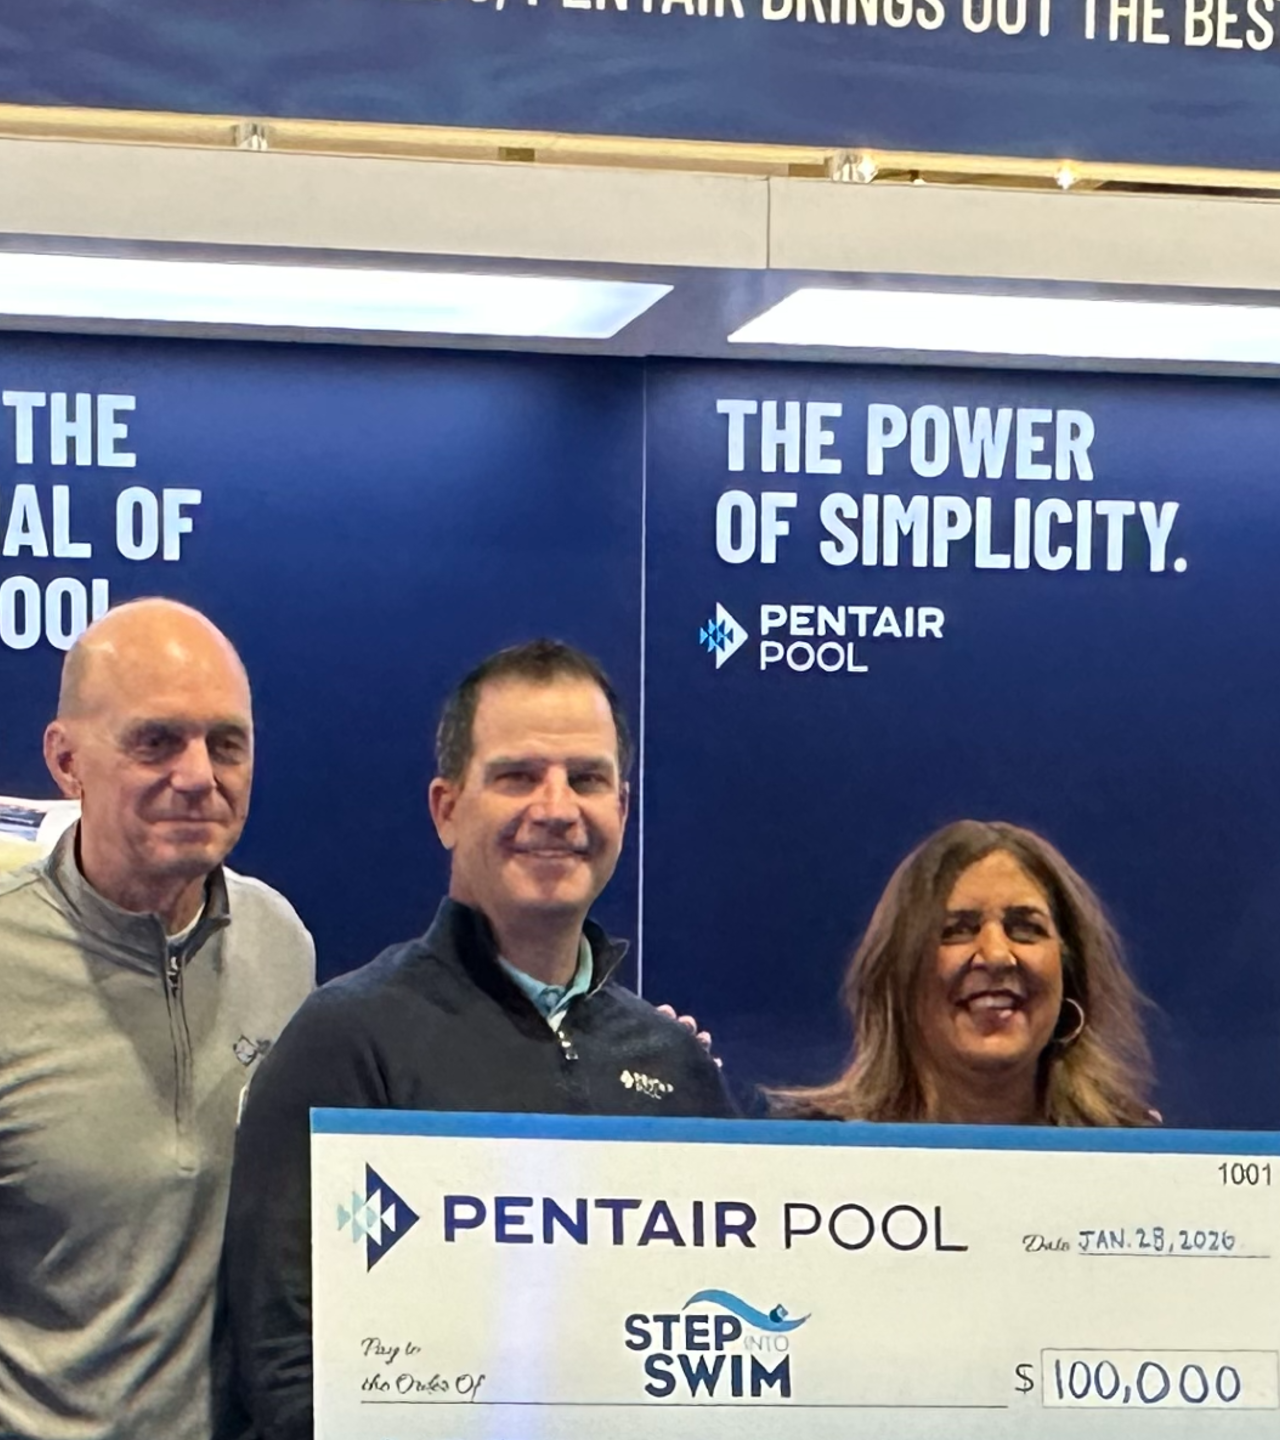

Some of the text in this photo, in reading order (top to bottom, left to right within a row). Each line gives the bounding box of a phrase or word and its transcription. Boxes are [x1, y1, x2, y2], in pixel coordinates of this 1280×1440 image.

[1080, 0, 1170, 45] THE
[2, 391, 137, 467] THE
[716, 399, 1095, 480] THE POWER
[115, 485, 203, 561] OF
[715, 490, 1188, 573] OF SIMPLICITY.
[760, 604, 946, 639] PENTAIR
[760, 640, 868, 673] POOL
[1218, 1162, 1272, 1187] 1001
[443, 1195, 968, 1251] PENTAIR POOL
[361, 1337, 401, 1365] Pay
[625, 1314, 790, 1353] STEP INTO
[361, 1373, 486, 1402] the Order Of
[645, 1354, 792, 1398] SWIM
[1013, 1360, 1242, 1405] $ 100,000
